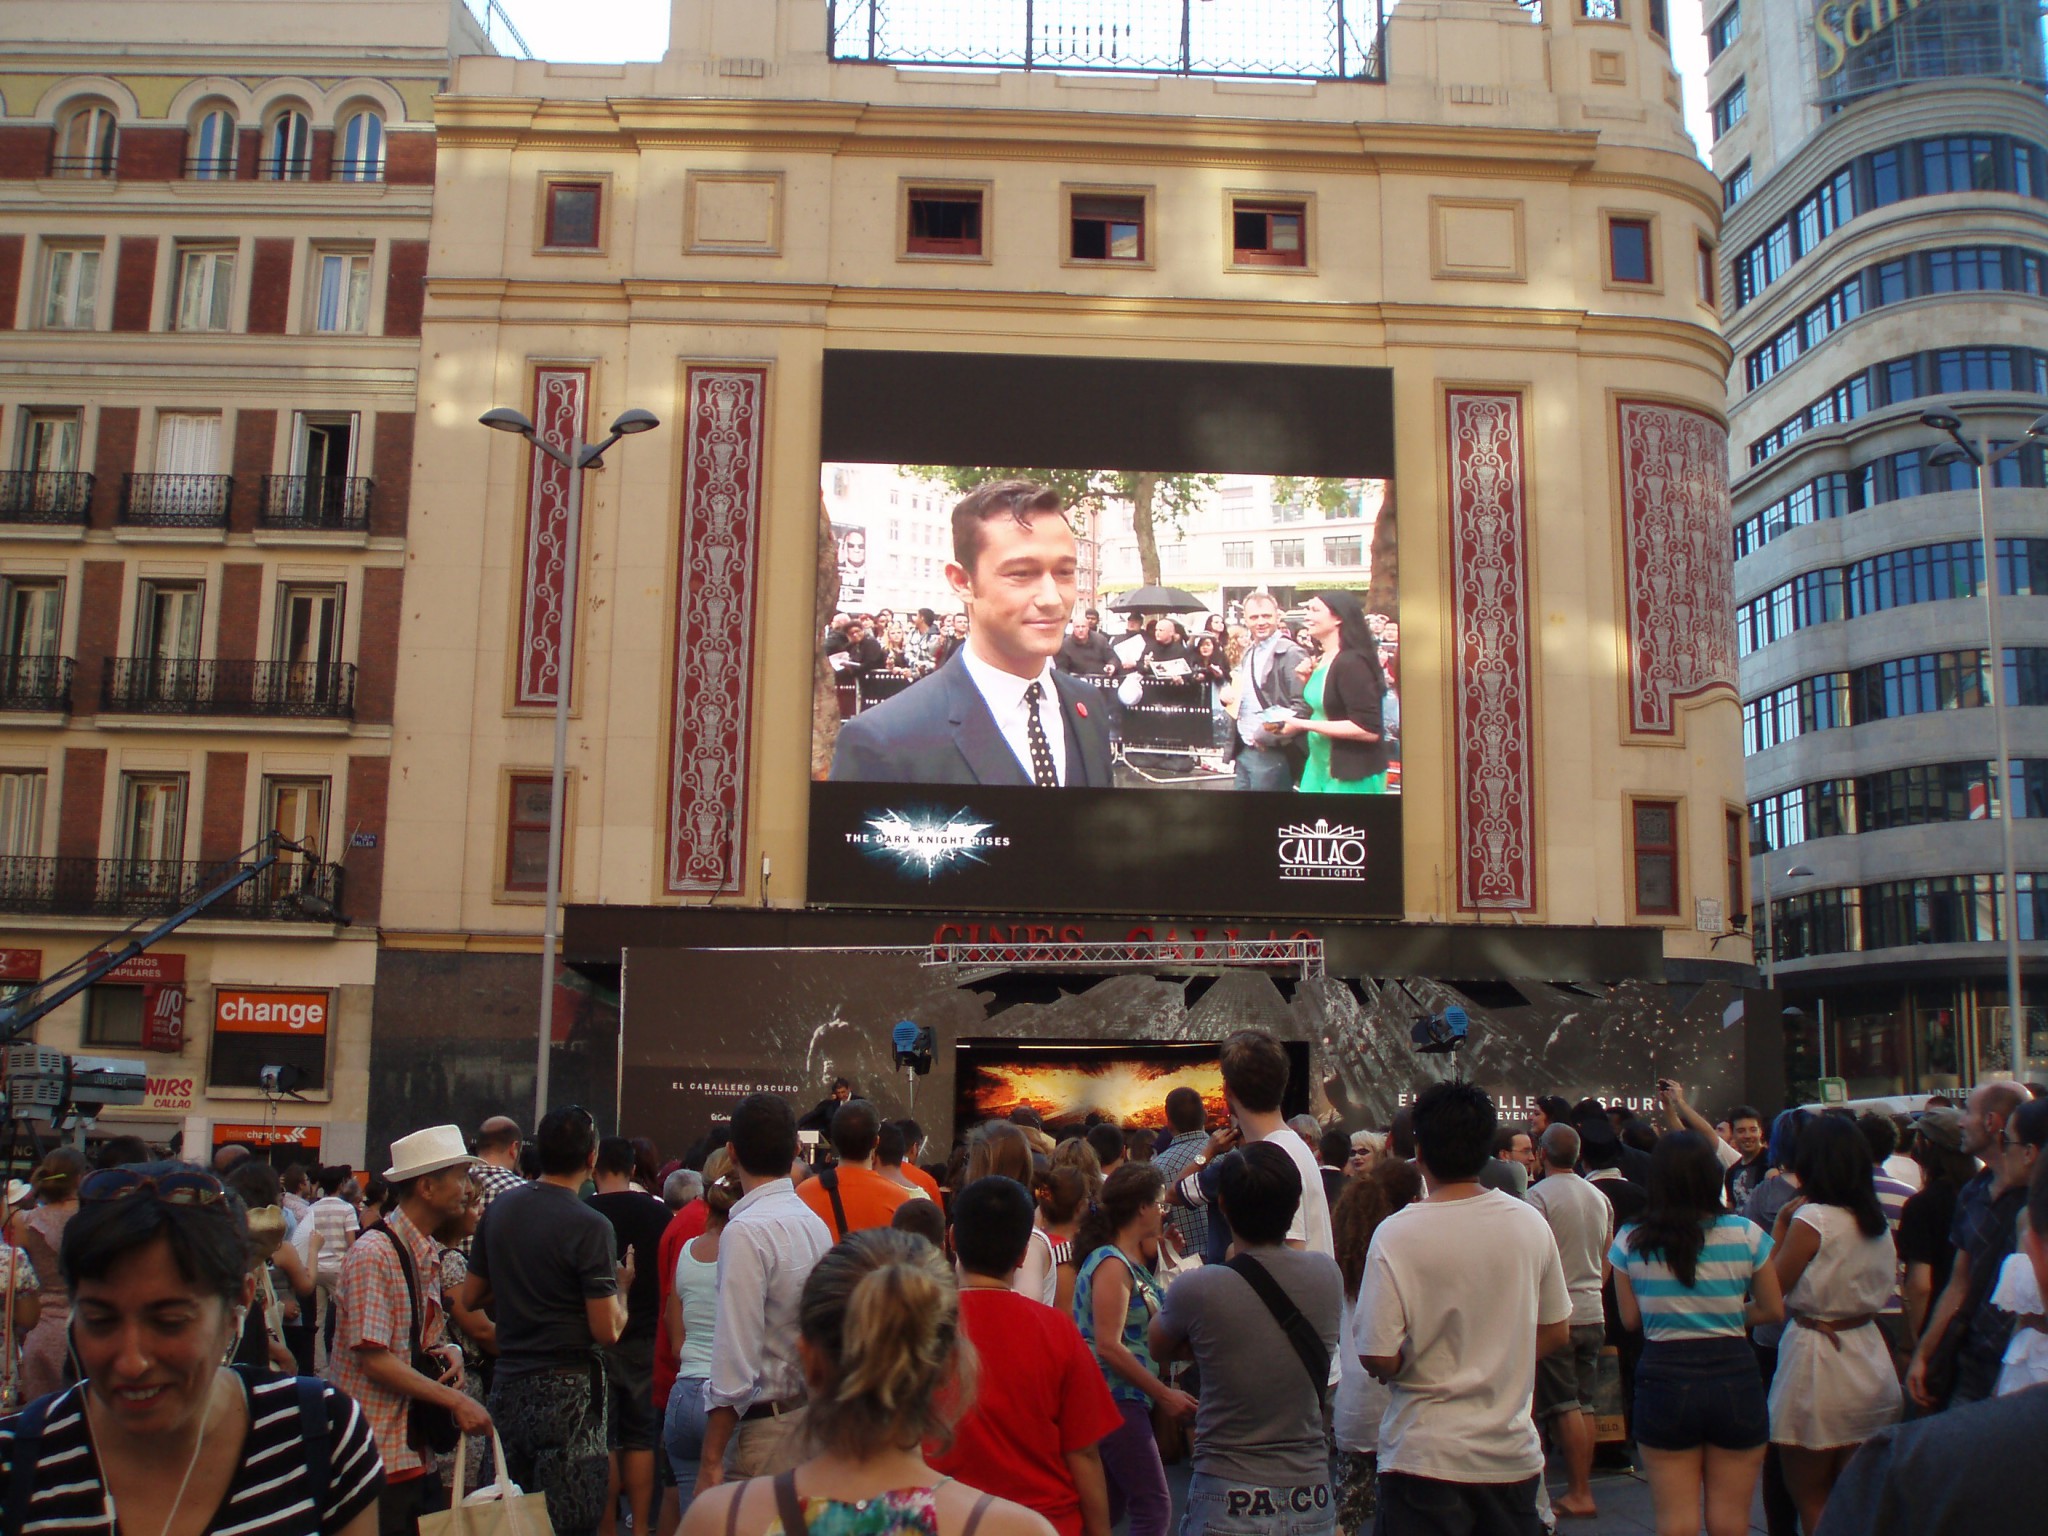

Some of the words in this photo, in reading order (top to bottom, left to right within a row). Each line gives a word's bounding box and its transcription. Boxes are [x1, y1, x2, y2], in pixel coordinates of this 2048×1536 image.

[845, 833, 870, 843] THE
[874, 835, 911, 844] DARK
[917, 836, 965, 845] KNIGHT
[971, 837, 1011, 846] RISES
[1279, 839, 1365, 866] CALLAO
[1285, 867, 1311, 876] CITY
[1321, 868, 1361, 877] LIGHTS
[933, 922, 1086, 964] CINES
[221, 997, 323, 1028] change
[672, 1082, 684, 1090] EL
[689, 1083, 751, 1091] CABALLERO
[756, 1085, 799, 1093] OSCURO
[154, 1098, 191, 1109] CALLAO
